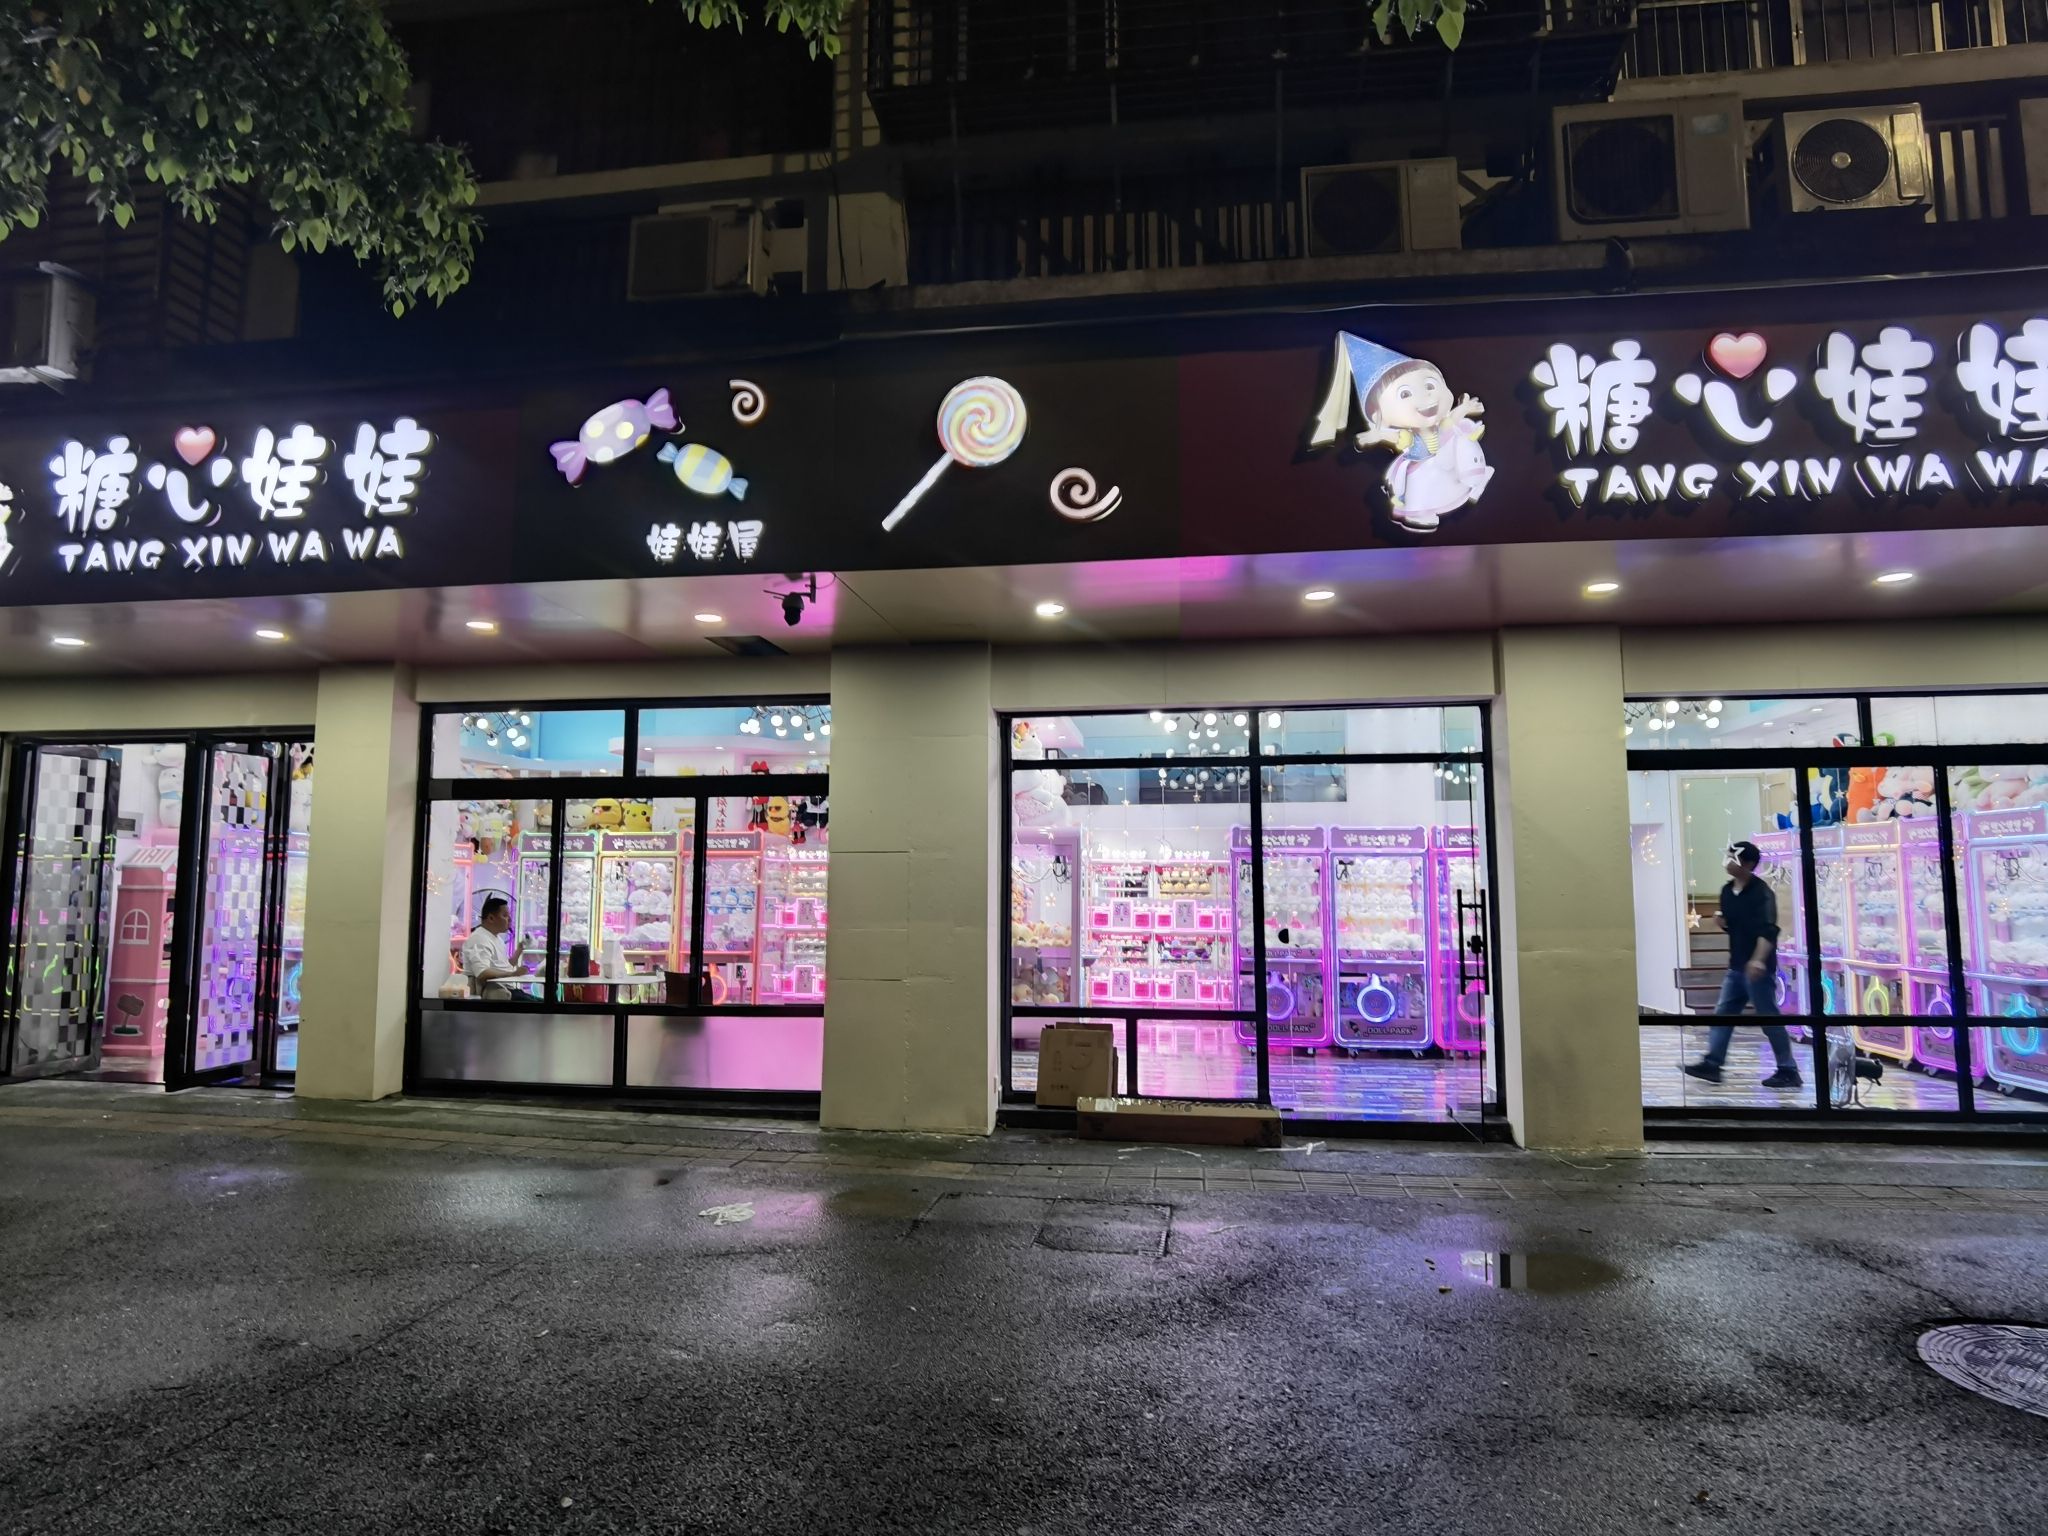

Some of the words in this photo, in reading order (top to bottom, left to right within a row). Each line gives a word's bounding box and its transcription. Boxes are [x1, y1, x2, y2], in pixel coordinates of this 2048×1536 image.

[49, 418, 430, 532] 糖心娃娃
[1563, 463, 1718, 502] TANG
[1741, 457, 1841, 496] XIN
[1866, 453, 1954, 491] WA
[58, 540, 165, 572] TANG
[181, 534, 252, 567] XIN
[267, 530, 325, 562] WA
[342, 526, 400, 559] WA
[646, 520, 763, 560] 娃娃屋
